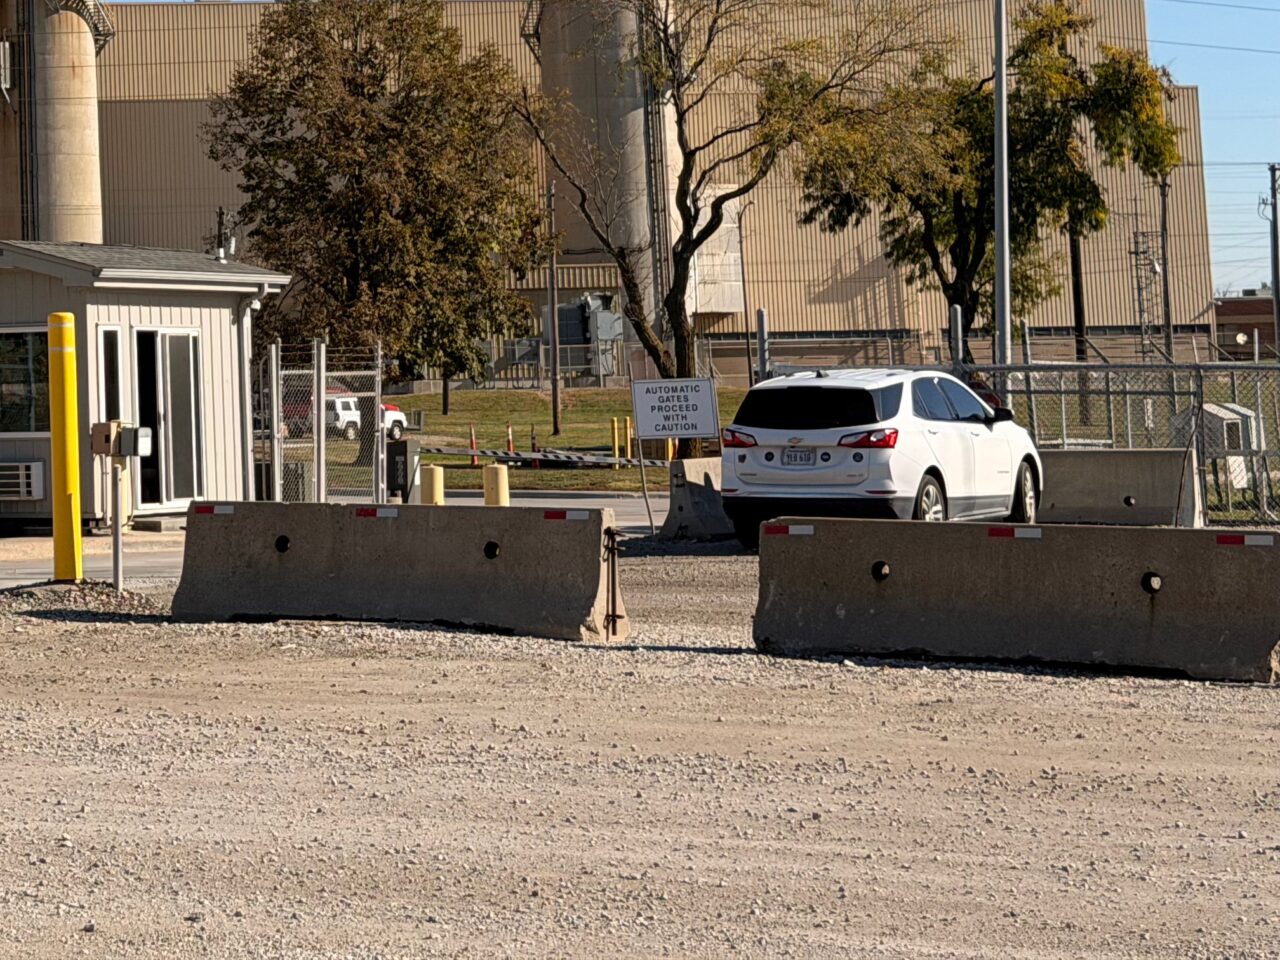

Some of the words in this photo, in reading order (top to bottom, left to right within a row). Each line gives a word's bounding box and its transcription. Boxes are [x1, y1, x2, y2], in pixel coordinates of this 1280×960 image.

[645, 385, 701, 394] AUTOMATIC
[658, 395, 689, 403] GATES
[650, 404, 698, 413] PROCEED
[662, 413, 688, 422] WITH
[654, 422, 698, 432] CAUTION
